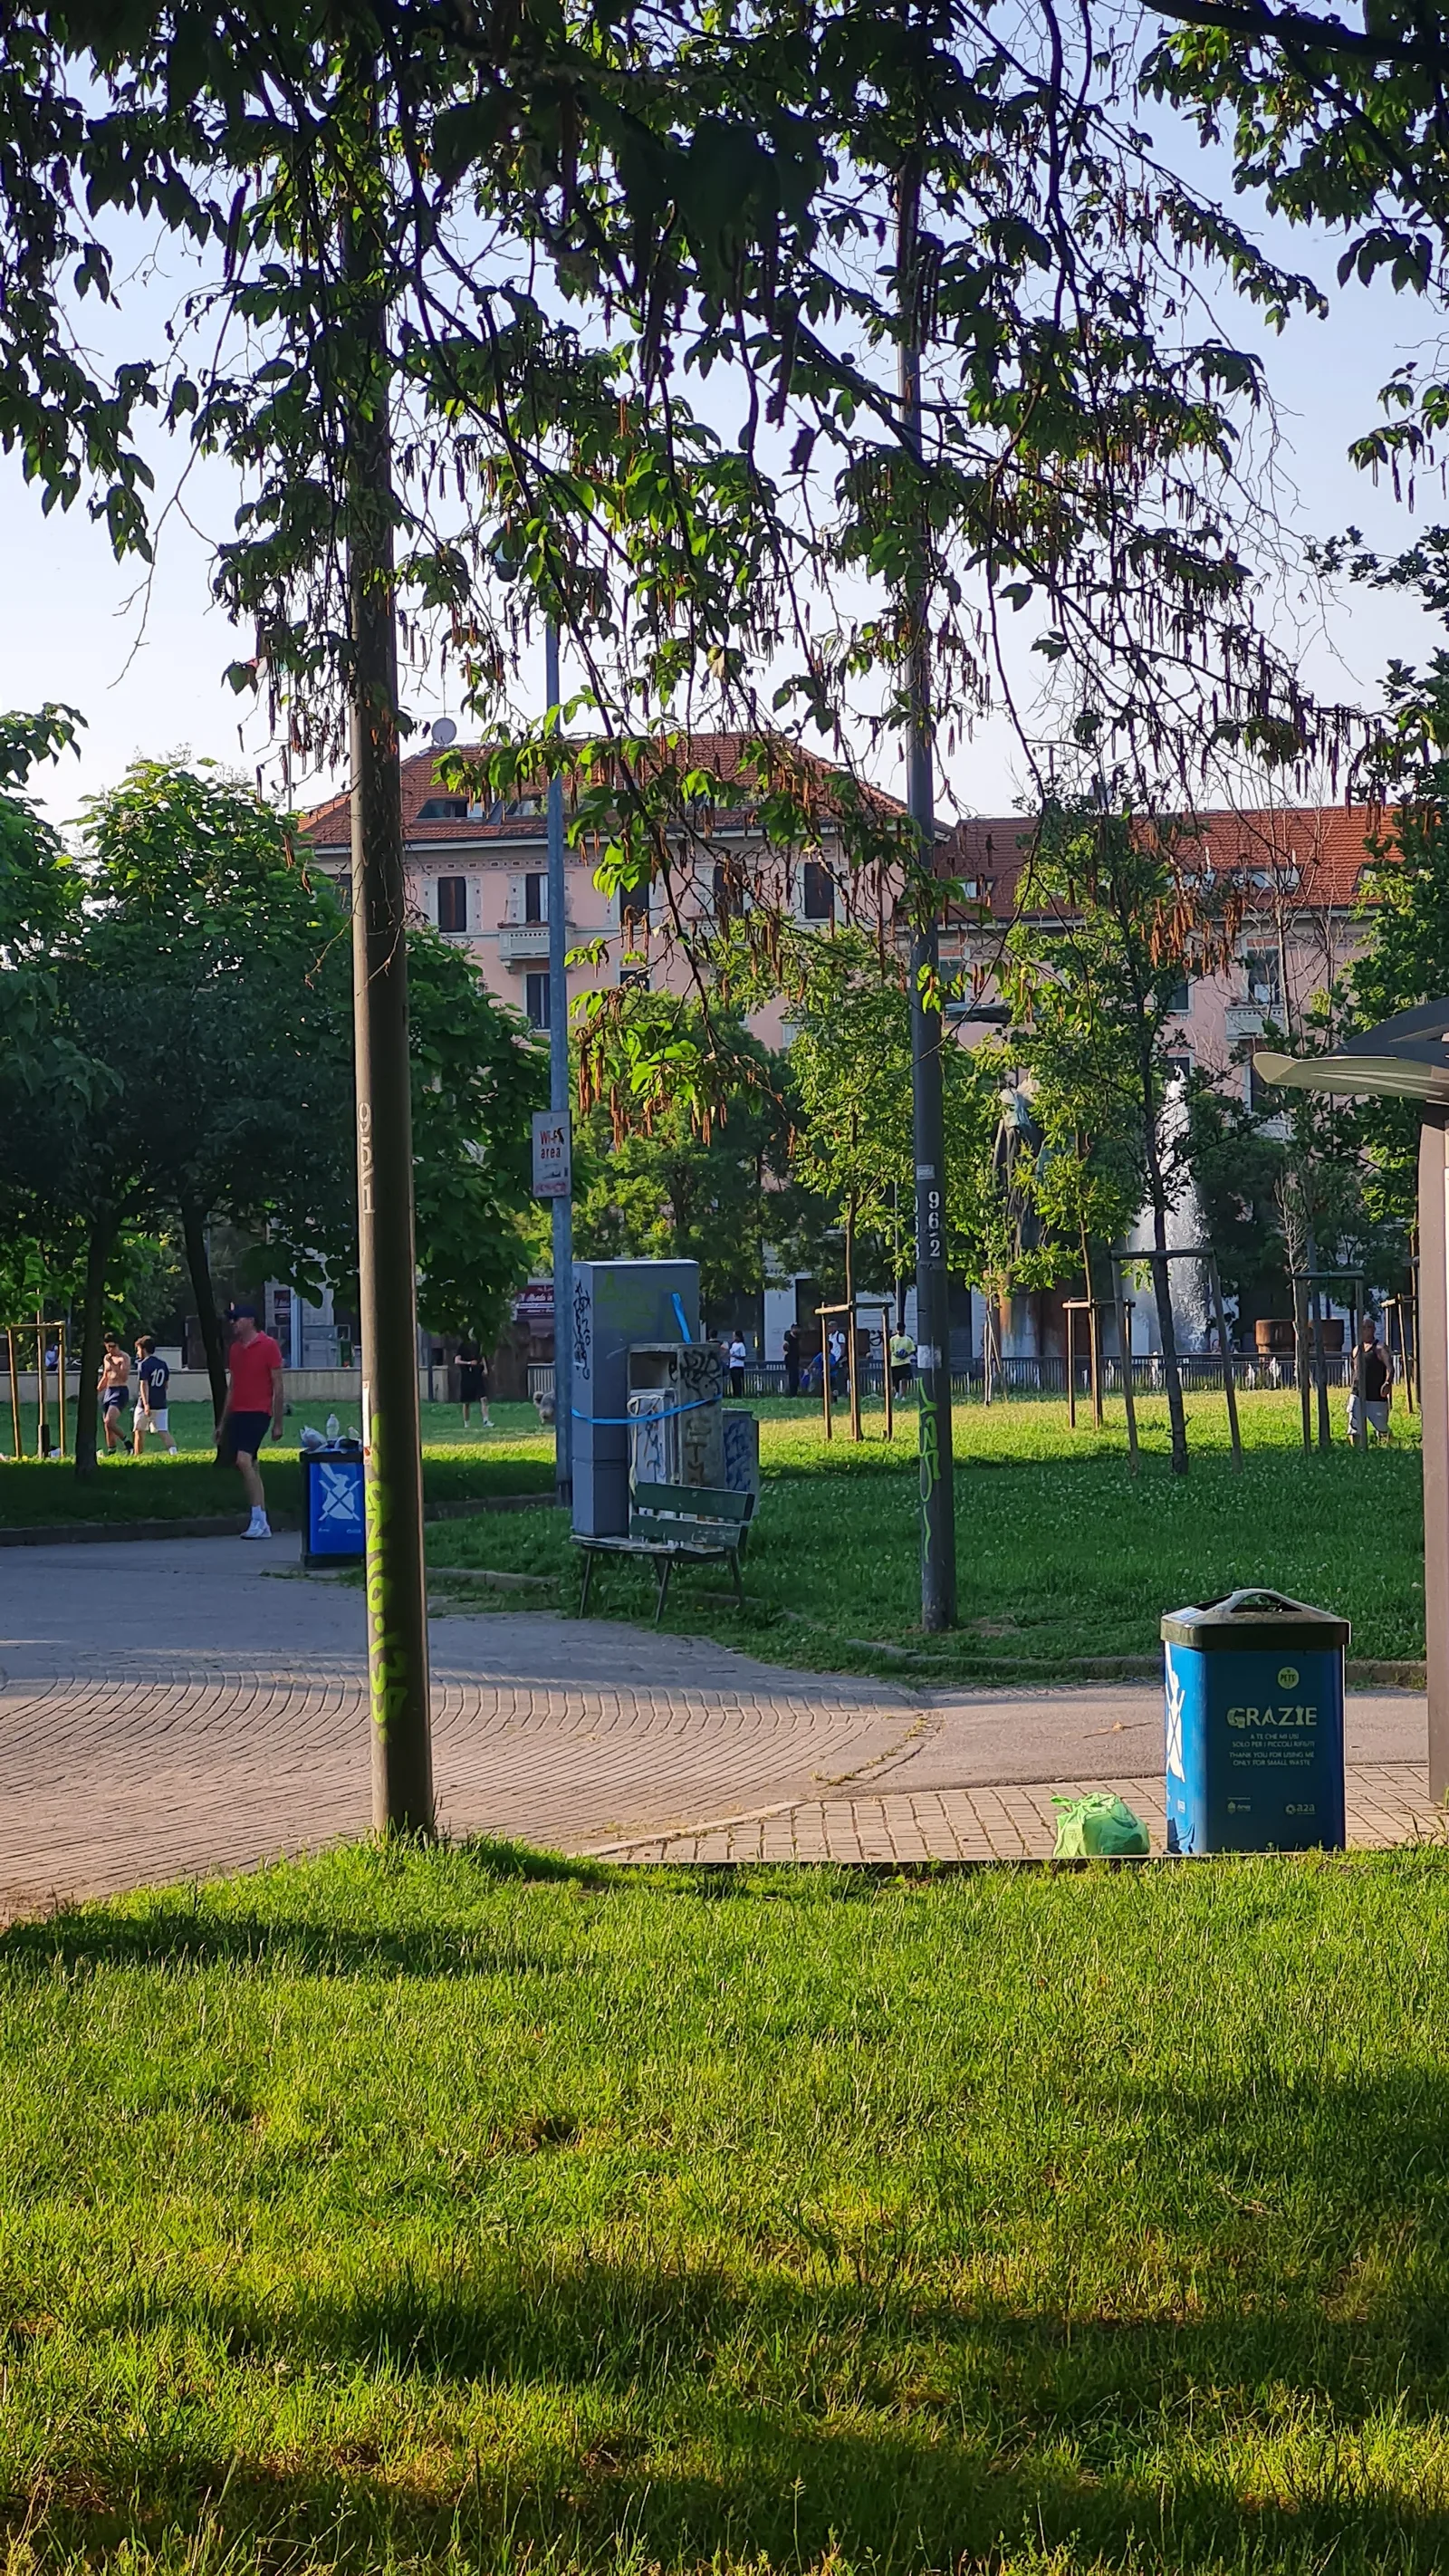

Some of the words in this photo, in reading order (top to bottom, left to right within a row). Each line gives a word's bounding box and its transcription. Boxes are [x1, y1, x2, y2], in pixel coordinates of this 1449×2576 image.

[540, 1147, 561, 1159] area
[150, 1368, 165, 1388] 10
[1226, 1705, 1318, 1729] GRAZIE
[1232, 1740, 1251, 1748] SOLO
[1252, 1740, 1262, 1748] PER
[1267, 1740, 1292, 1748] PICCOLI
